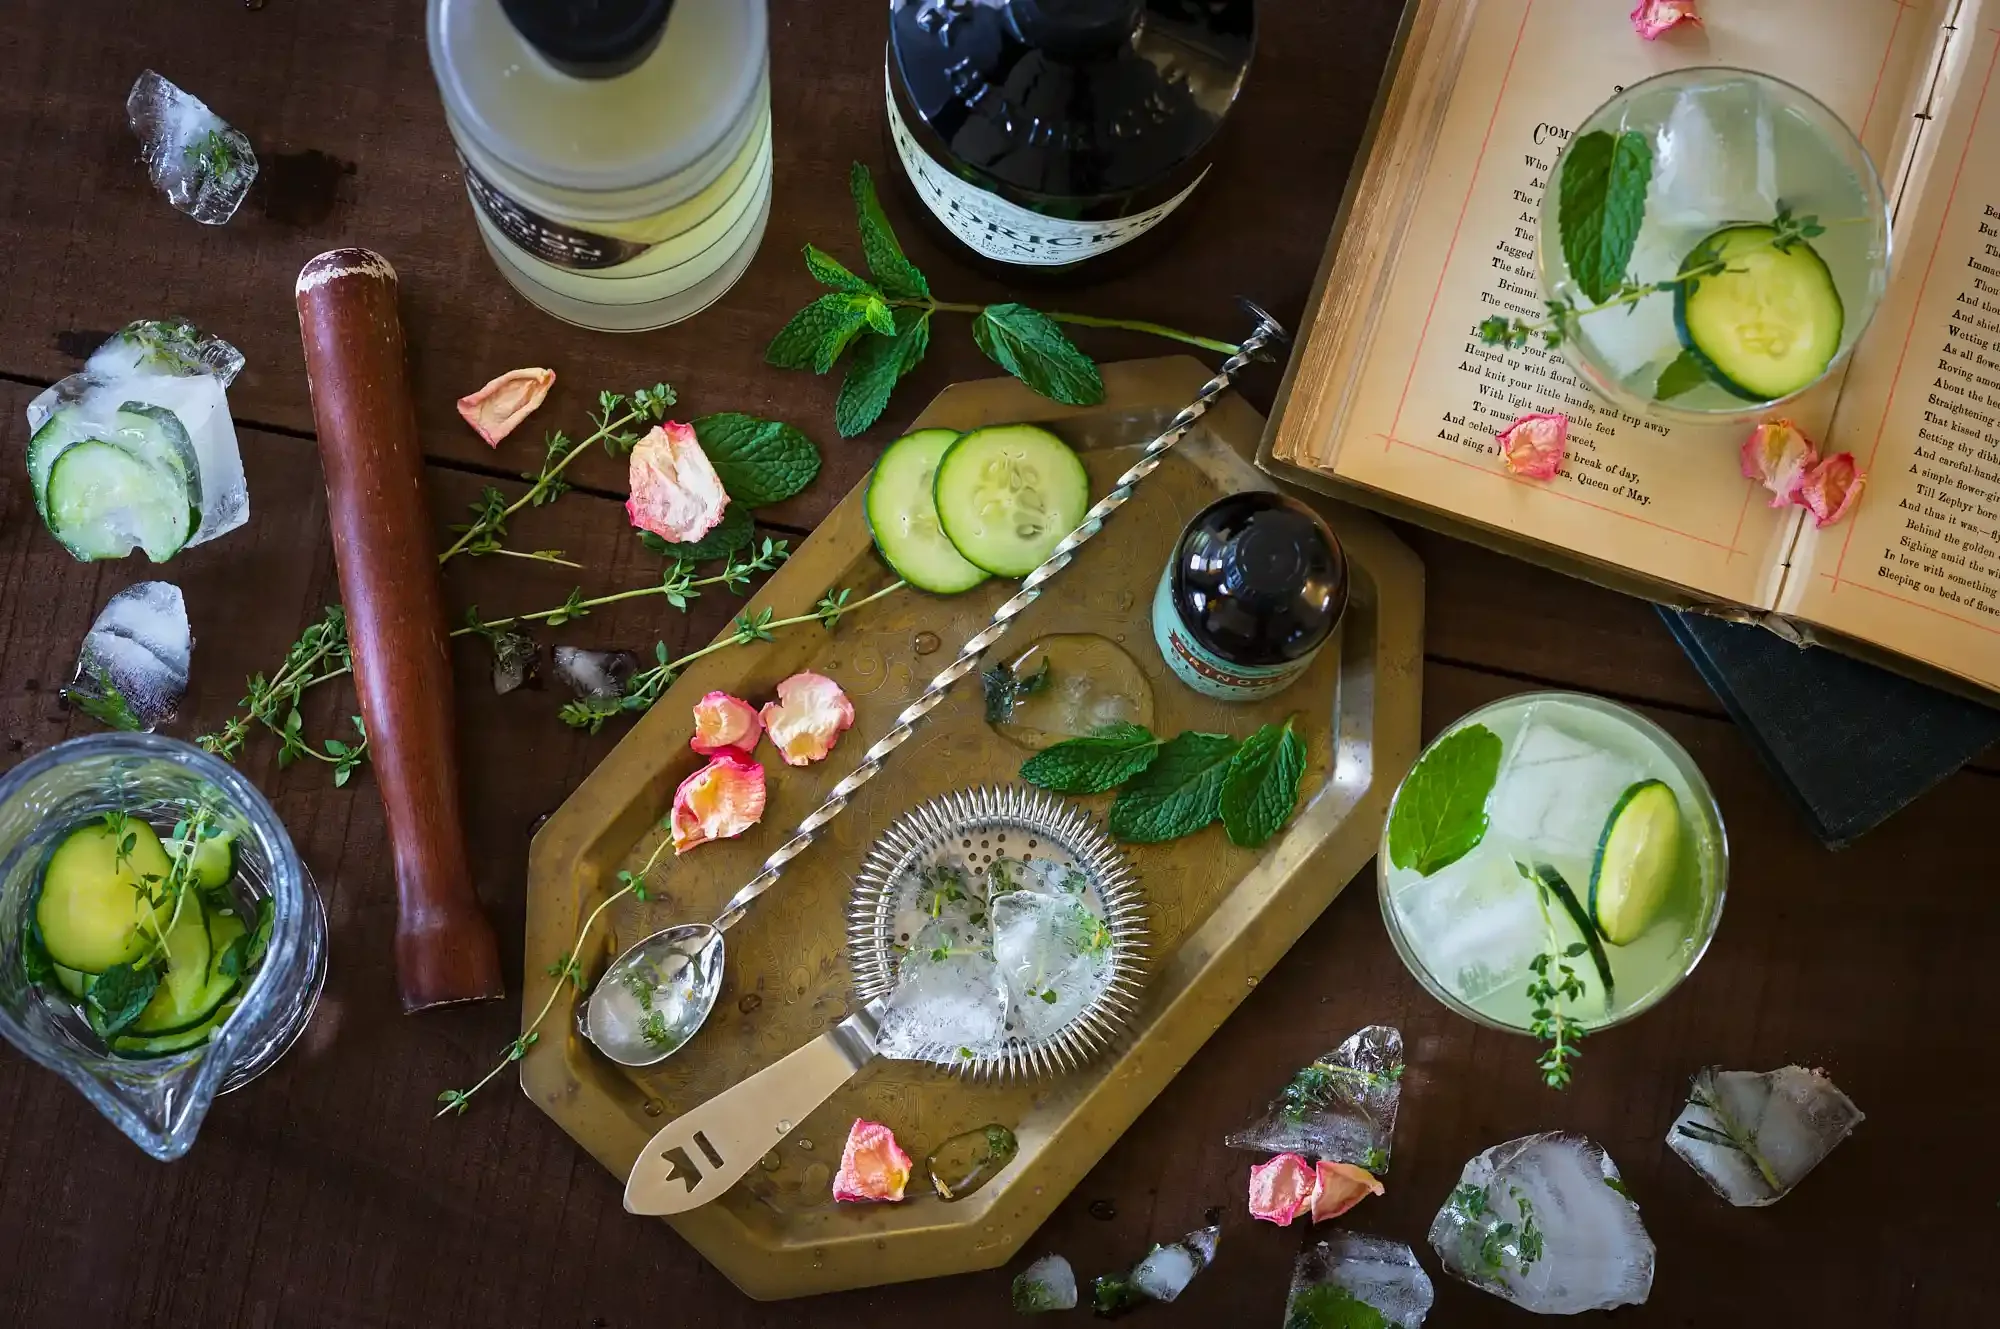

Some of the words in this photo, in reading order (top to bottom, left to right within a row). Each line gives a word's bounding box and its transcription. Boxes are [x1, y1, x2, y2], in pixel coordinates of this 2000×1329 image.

[1533, 122, 1574, 145] COM
[1525, 154, 1548, 171] Who
[1529, 177, 1548, 189] An
[1513, 189, 1533, 205] The
[1514, 226, 1534, 241] The
[1978, 221, 1998, 238] But
[1496, 240, 1534, 260] Jagged
[1985, 242, 2000, 259] Th
[1491, 256, 1512, 272] The
[1514, 265, 1537, 280] shri
[1497, 277, 1539, 300] Brimmi
[1956, 292, 1979, 307] And
[1481, 291, 1501, 306] The
[1503, 301, 1541, 319] censers
[1951, 309, 1974, 324] And
[1976, 318, 2000, 334] shiel
[1948, 324, 1989, 350] Wetting
[1464, 342, 1504, 364] Heaped
[1507, 358, 1520, 371] up
[1524, 363, 1546, 377] with
[1550, 370, 1577, 387] floral
[1521, 345, 1547, 359] your
[1942, 342, 1957, 355] As
[1960, 349, 1974, 361] all
[1976, 354, 2000, 372] flowe
[1937, 358, 1974, 382] Roving
[1458, 360, 1482, 375] And
[1484, 367, 1506, 383] knit
[1507, 377, 1533, 391] your
[1536, 383, 1561, 400] little
[1564, 393, 1596, 414] hands,
[1600, 407, 1619, 419] and
[1622, 412, 1641, 428] trip
[1644, 422, 1671, 437] away
[1933, 376, 1965, 396] About
[1968, 389, 1984, 403] the
[1479, 383, 1504, 401] With
[1508, 392, 1532, 408] light
[1535, 404, 1554, 416] and
[1595, 422, 1616, 437] feet
[1928, 393, 1995, 428] Straightening
[1472, 400, 1487, 414] To
[1565, 432, 1596, 451] sweet,
[1924, 410, 1948, 428] That
[1951, 420, 1981, 439] kissed
[1984, 433, 2000, 448] thy
[1442, 411, 1466, 426] And
[1468, 420, 1502, 437] celebr
[1574, 451, 1602, 470] break
[1605, 464, 1620, 474] of
[1619, 466, 1641, 484] day,
[1913, 445, 1937, 461] And
[1918, 427, 1954, 451] Setting
[1957, 442, 1974, 457] thy
[1437, 428, 1460, 443] And
[1462, 437, 1484, 454] sing
[1487, 446, 1493, 454] a
[1577, 472, 1609, 491] Queen
[1612, 485, 1625, 495] of
[1626, 487, 1652, 506] May.
[1908, 463, 1918, 474] A
[1921, 468, 1954, 486] simple
[1898, 497, 1922, 512] And
[1924, 506, 1946, 521] thus
[1948, 513, 1957, 525] it
[1916, 483, 1936, 499] Till
[1938, 491, 1974, 513] Zephyr
[1977, 504, 1998, 521] bore
[1905, 517, 1941, 539] Behind
[1944, 533, 1961, 546] the
[1962, 540, 1995, 559] golden
[1899, 535, 1939, 559] Sighing
[1941, 551, 1966, 566] amid
[1969, 560, 1985, 573] the
[1883, 547, 1896, 561] In
[1899, 553, 1920, 569] love
[1923, 564, 1945, 578] with
[1947, 572, 1998, 599] something
[1878, 566, 1922, 592] Sleeping
[1923, 583, 1936, 594] on
[1939, 586, 1961, 603] beds
[1964, 597, 1976, 608] of
